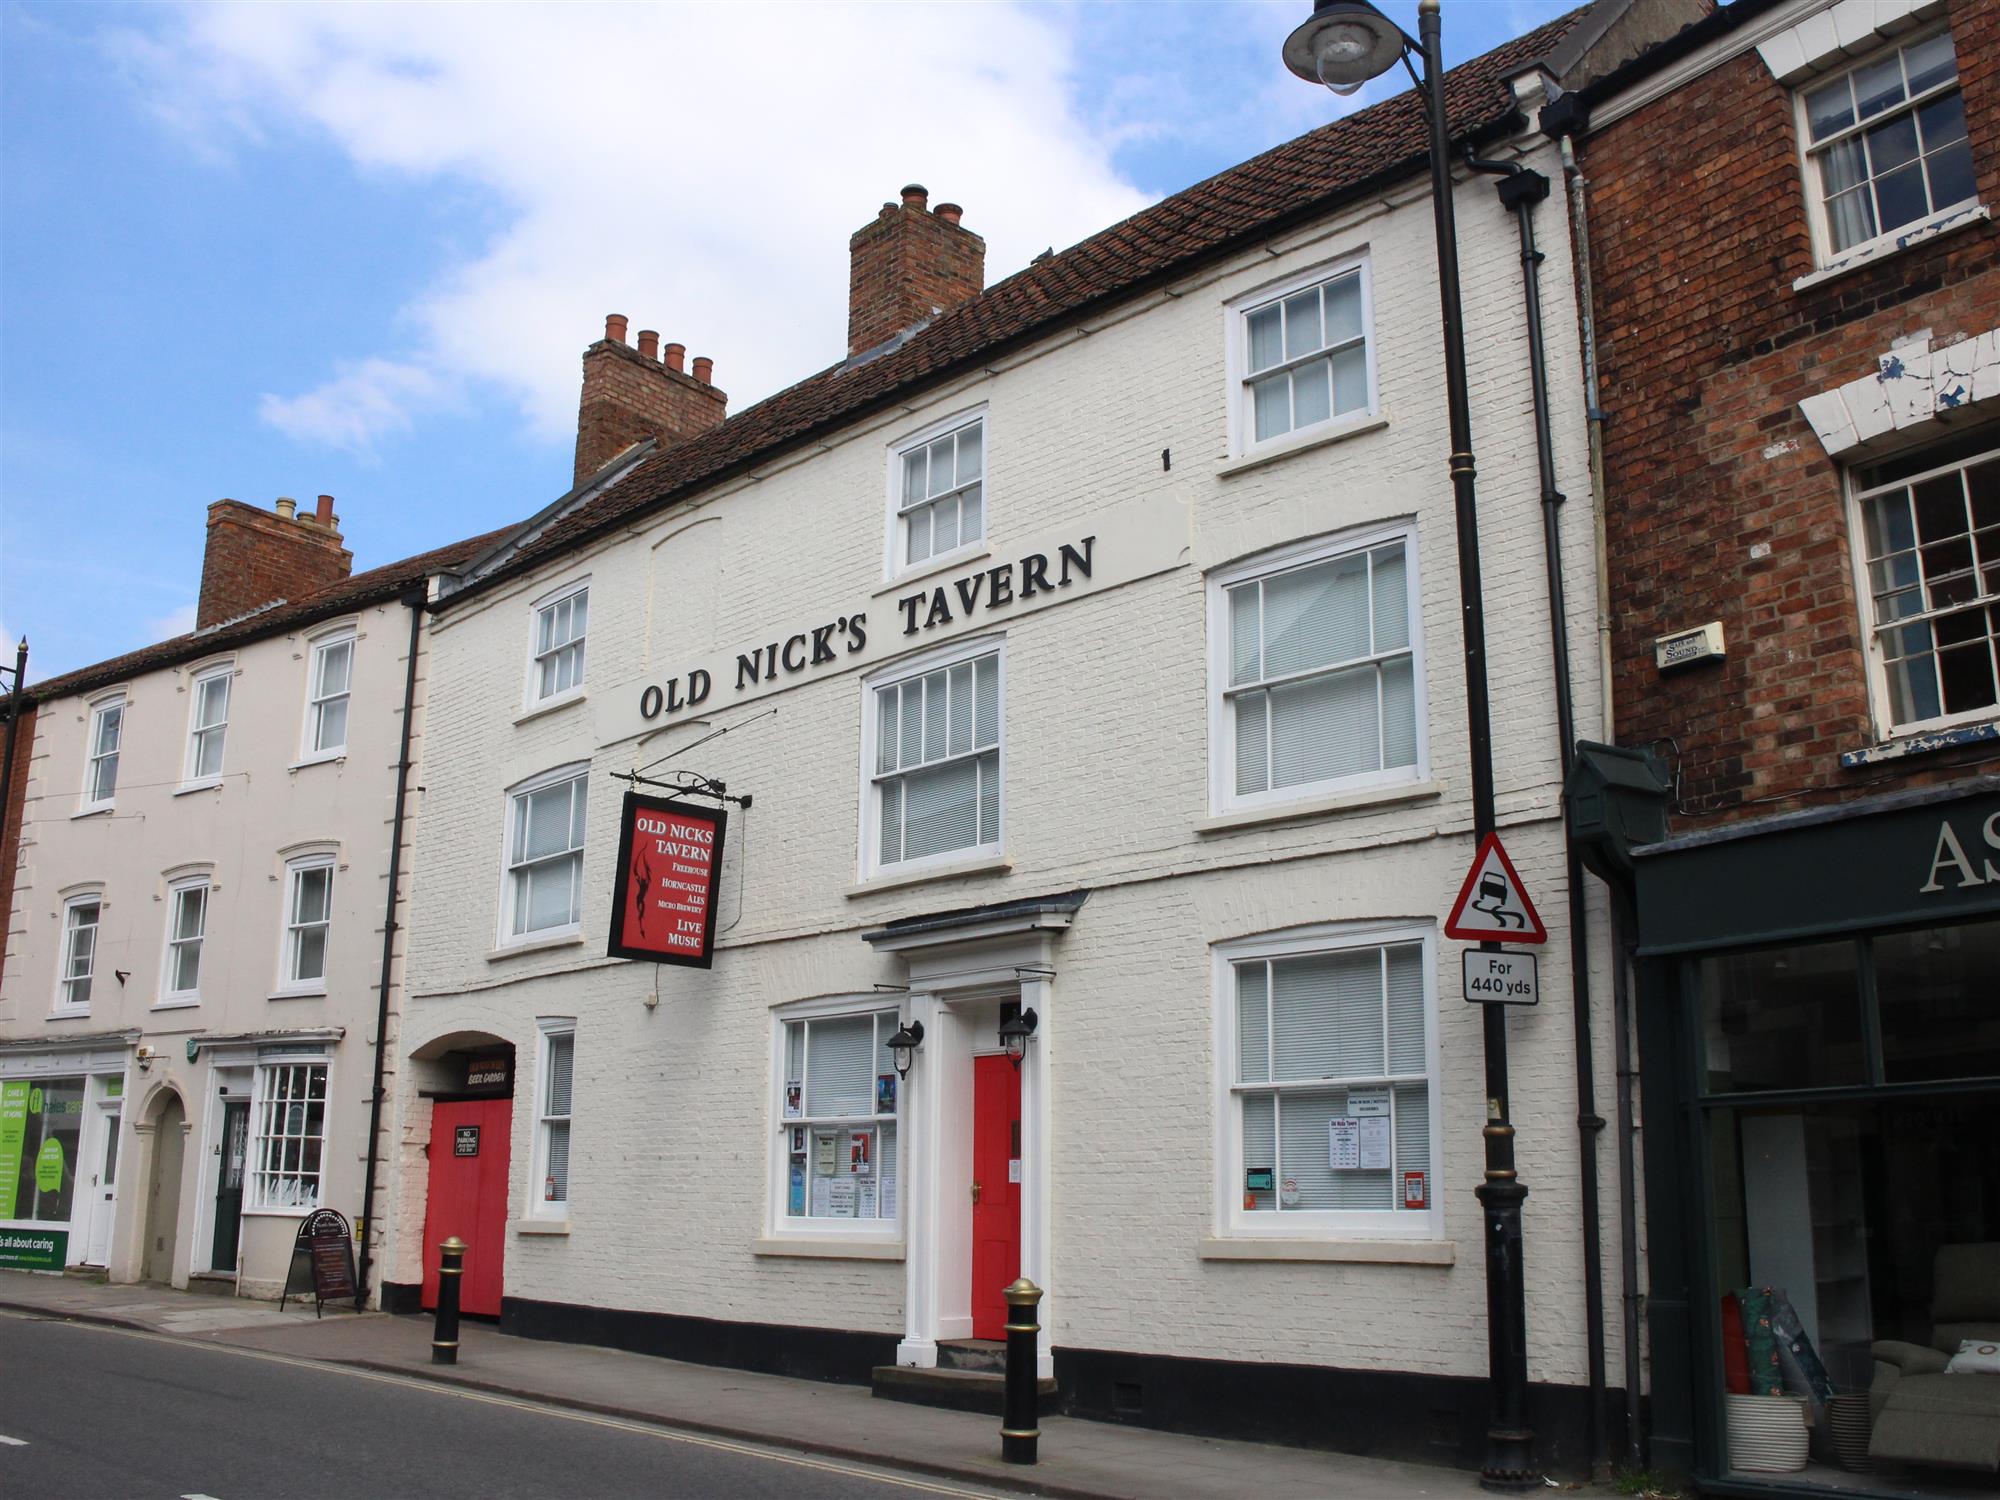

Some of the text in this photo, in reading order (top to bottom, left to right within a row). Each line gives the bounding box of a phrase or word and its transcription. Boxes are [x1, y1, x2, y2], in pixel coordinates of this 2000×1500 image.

[639, 535, 1096, 719] OLD NICK'S TAVERN
[637, 817, 714, 844] OLD NICKS
[655, 839, 711, 862] TAVERN
[672, 862, 709, 877] FREEHOUSE
[662, 877, 707, 894] HORNCASTLE
[657, 899, 703, 914] MICRO BREWERY
[687, 894, 705, 905] ALES
[676, 918, 702, 934] LIVE
[667, 932, 701, 949] MUSIC
[1489, 959, 1512, 975] For
[1471, 977, 1532, 997] 440 yds
[467, 1071, 507, 1086] BEER GARDEN
[456, 1136, 477, 1144] PARKING
[4, 1236, 13, 1248] all
[12, 1237, 33, 1249] about
[32, 1238, 54, 1252] caring
